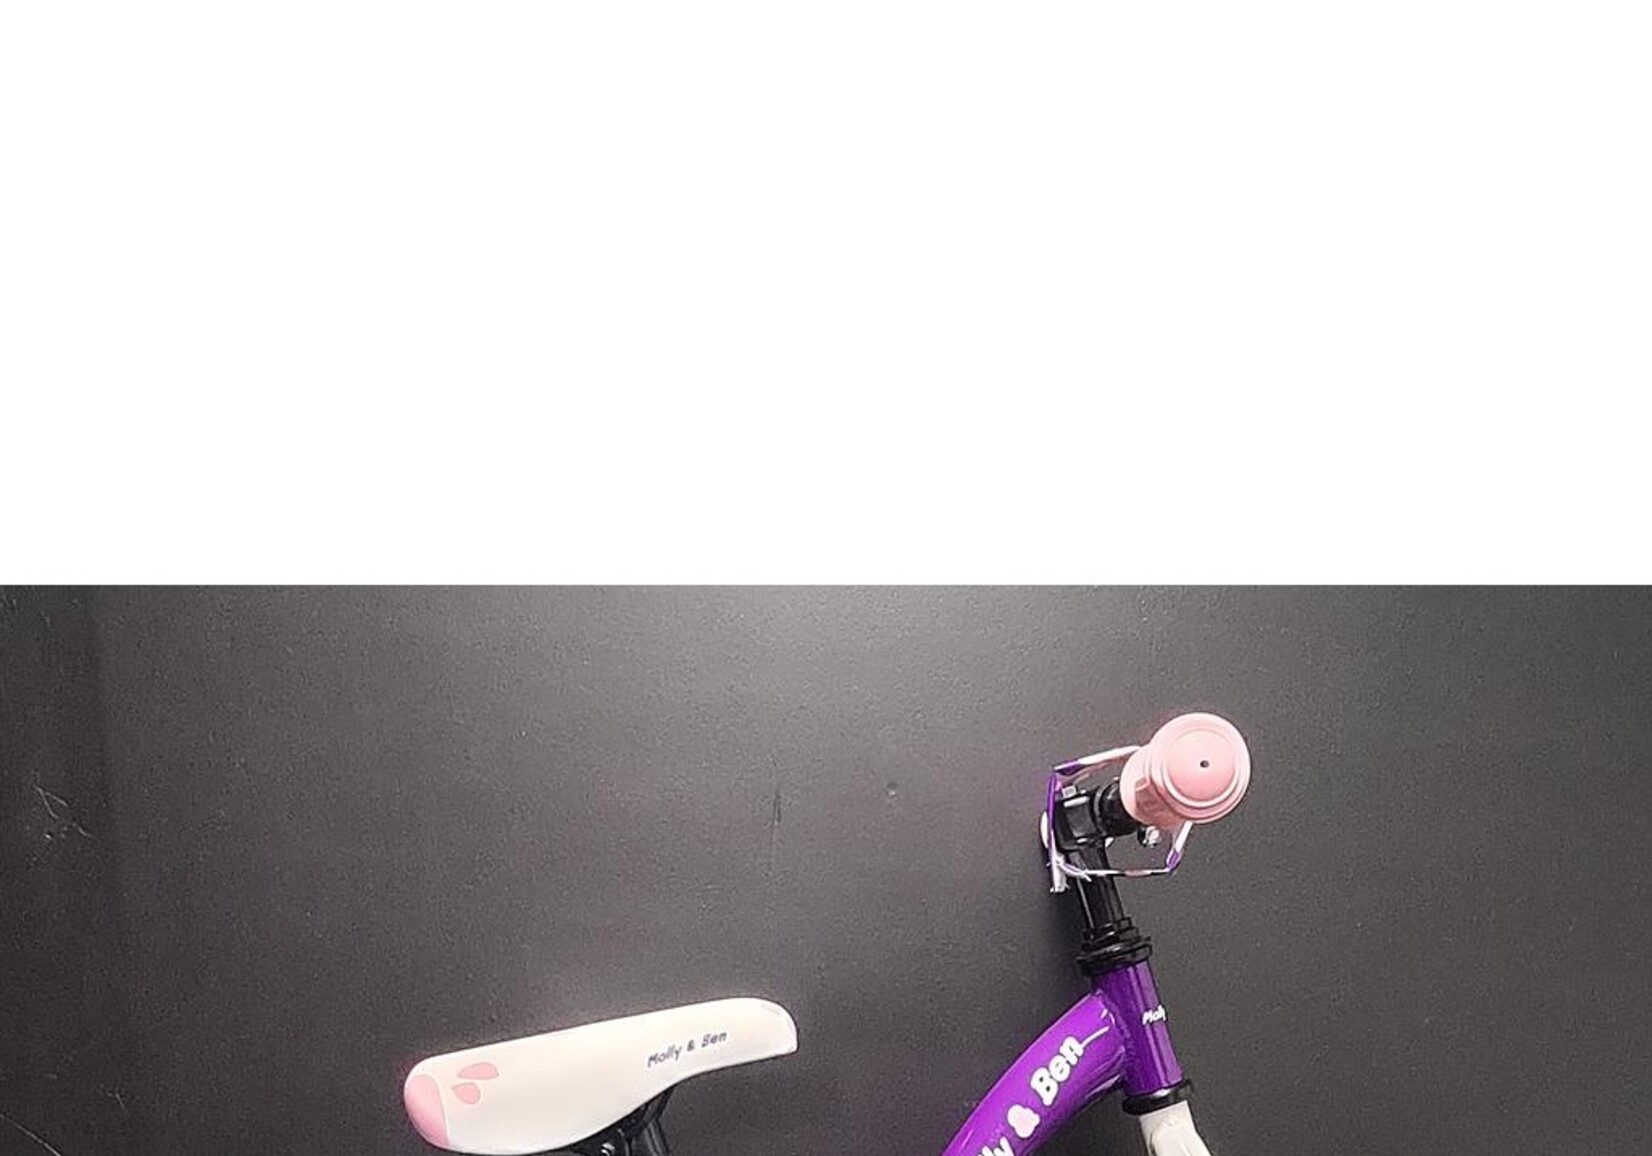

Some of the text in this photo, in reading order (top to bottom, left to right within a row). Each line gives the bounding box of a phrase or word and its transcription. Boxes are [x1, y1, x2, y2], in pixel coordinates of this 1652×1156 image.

[647, 1032, 727, 1068] Molly & Ben
[1030, 1036, 1084, 1106] Ben
